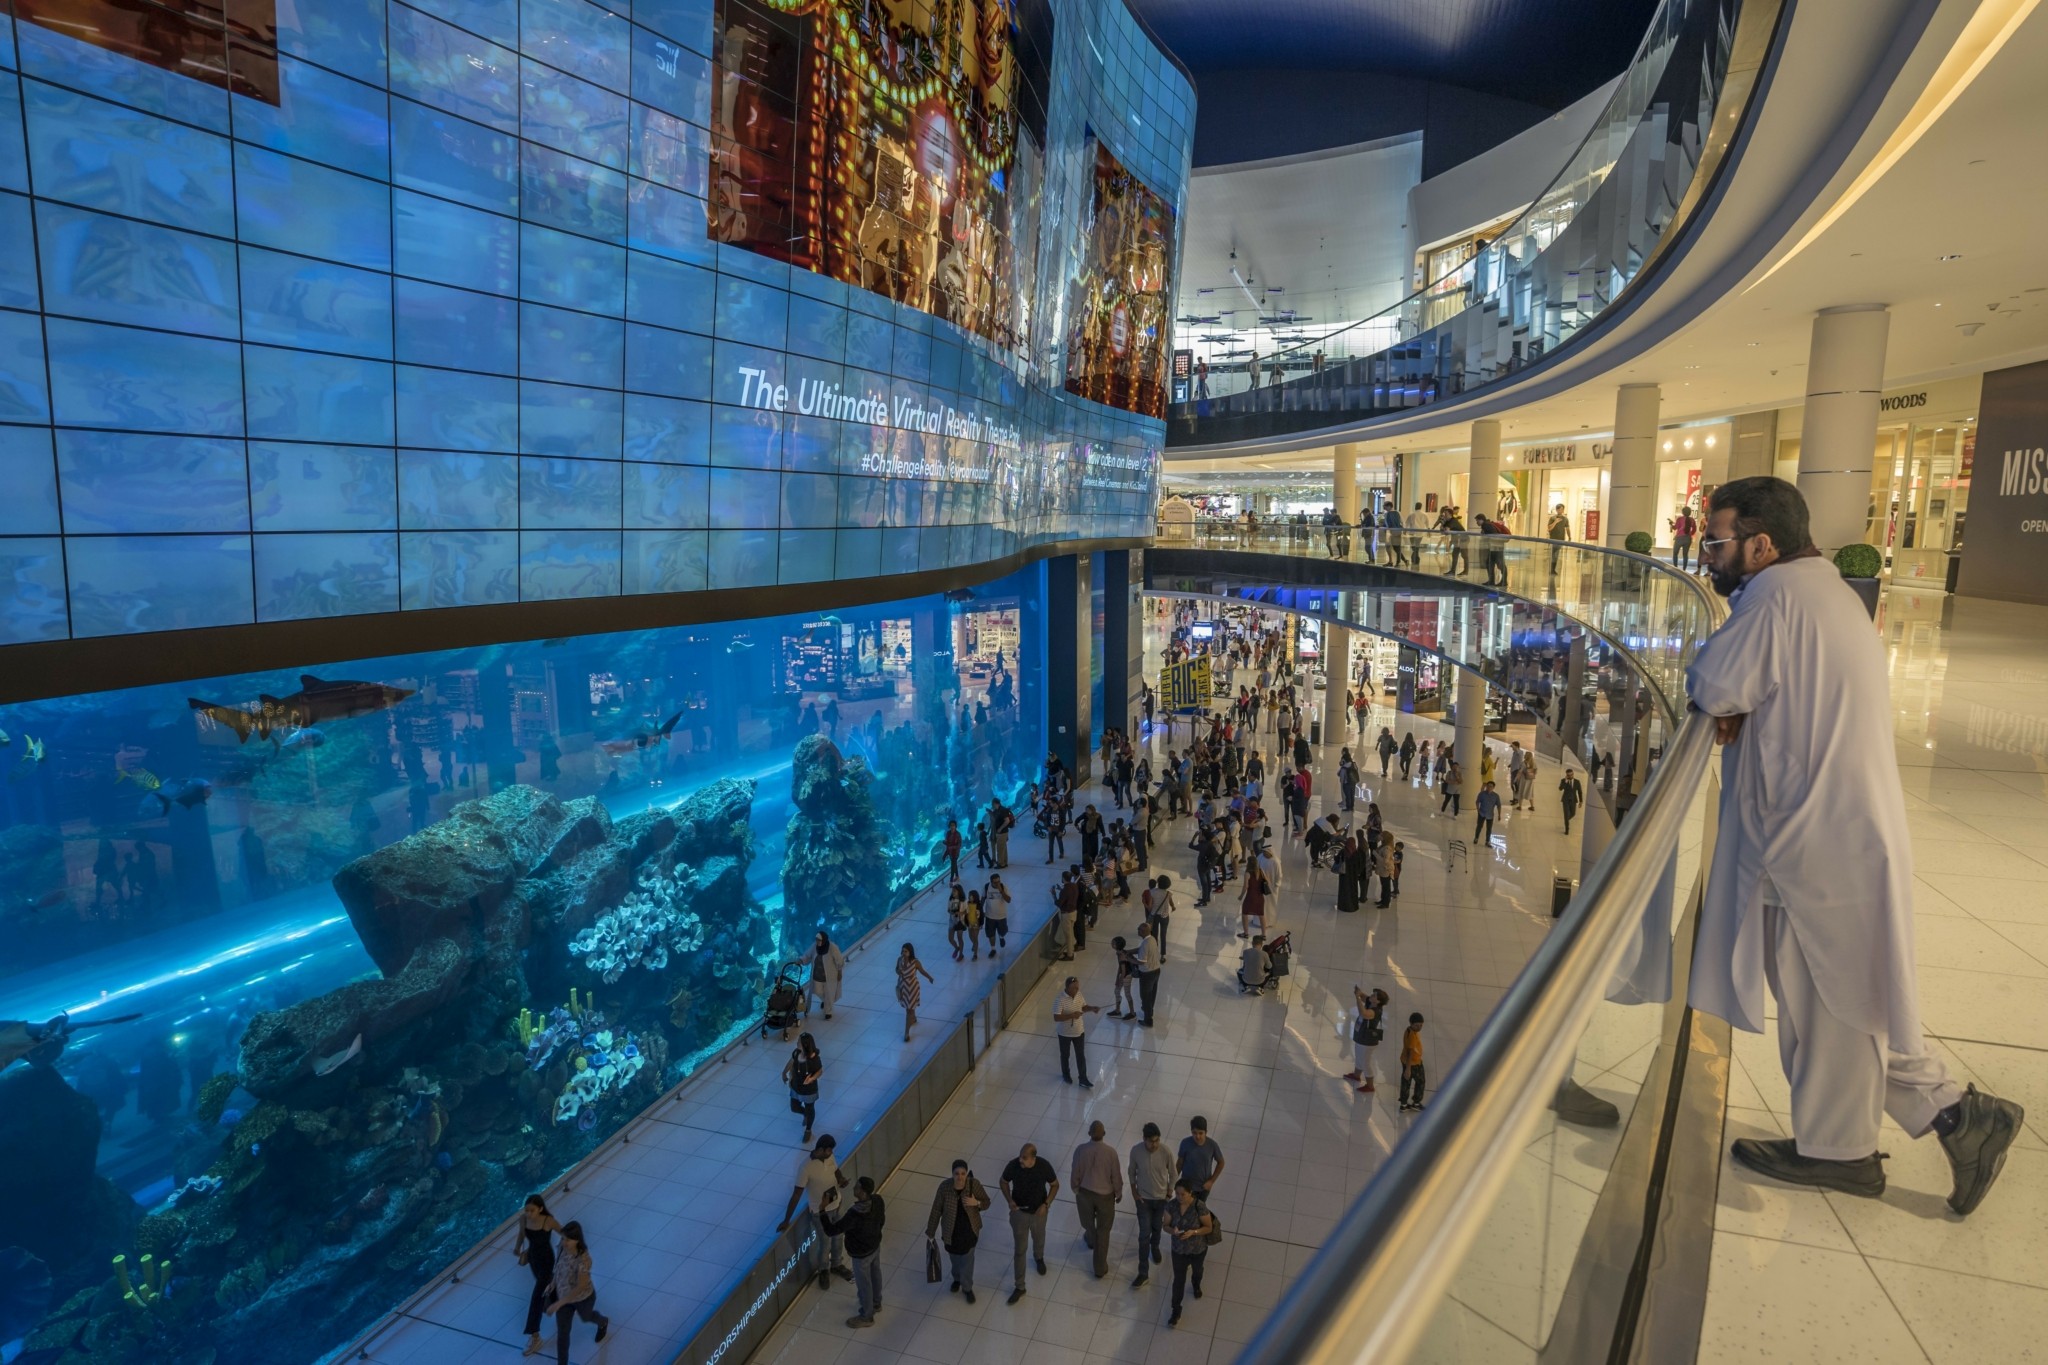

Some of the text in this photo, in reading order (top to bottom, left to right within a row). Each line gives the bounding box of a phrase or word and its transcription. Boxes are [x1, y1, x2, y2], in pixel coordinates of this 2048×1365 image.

[738, 366, 789, 412] The
[798, 377, 888, 425] Ultimate
[894, 395, 944, 434] Virtual
[945, 407, 982, 447] Reality
[1880, 392, 1927, 411] WOODS
[1523, 446, 1565, 465] FOREVER
[1566, 444, 1576, 461] 21
[1142, 459, 1148, 471] 2
[1398, 664, 1415, 673] ALDO
[1171, 660, 1197, 705] BIG
